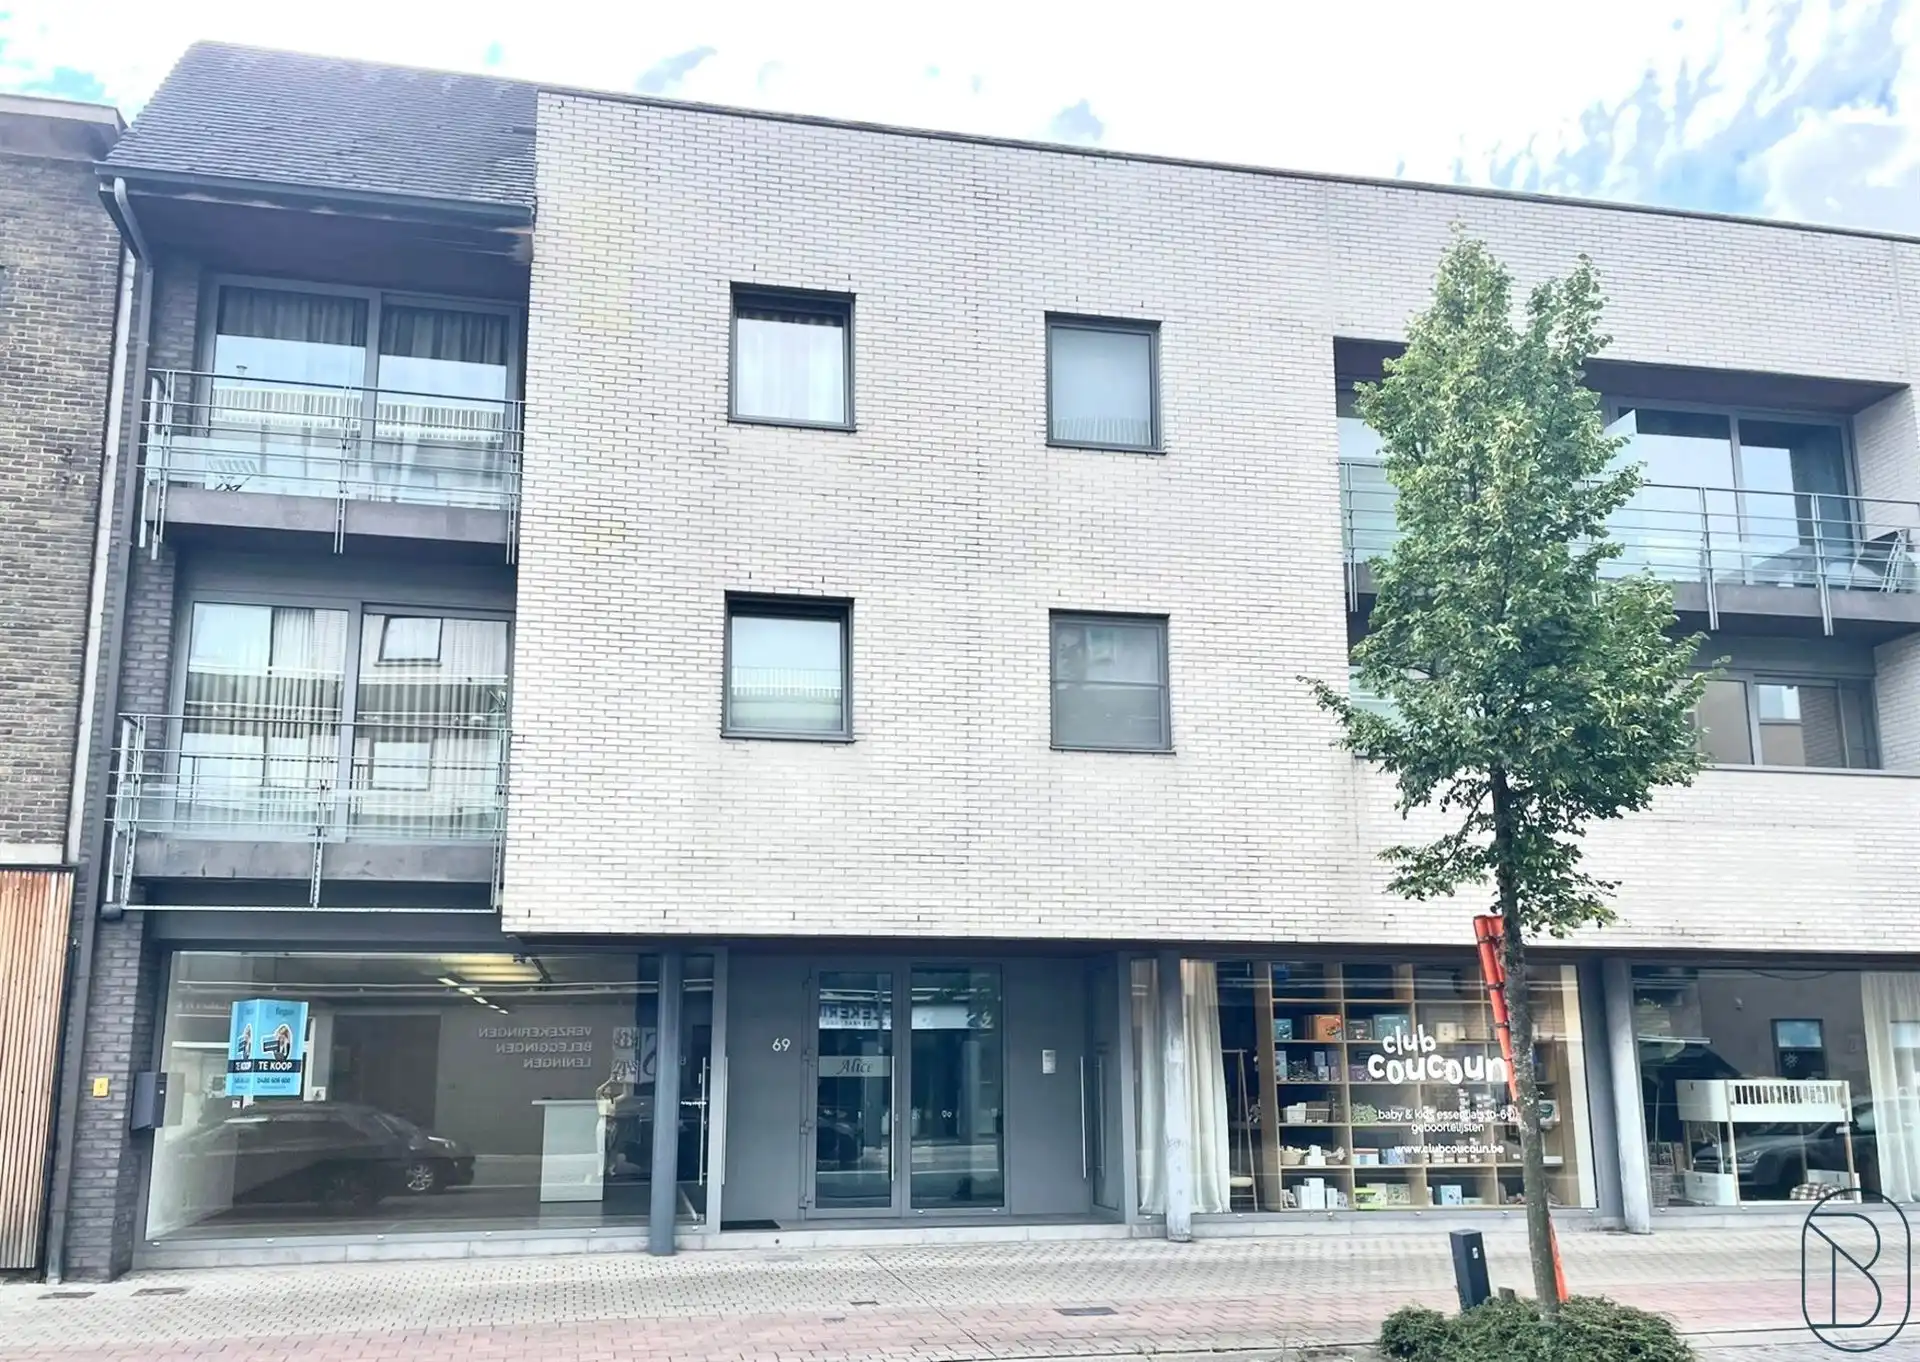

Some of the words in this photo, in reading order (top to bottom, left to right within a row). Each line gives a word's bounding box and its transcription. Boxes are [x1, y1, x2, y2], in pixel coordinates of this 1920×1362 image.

[772, 1038, 791, 1052] 69
[1382, 1024, 1436, 1055] club
[258, 1061, 268, 1070] TE
[270, 1061, 292, 1070] KOOP
[836, 1057, 874, 1075] Alice
[1367, 1054, 1508, 1085] coucoun
[1378, 1109, 1403, 1121] baby
[1405, 1109, 1414, 1120] &
[1415, 1109, 1434, 1120] kids
[1411, 1122, 1484, 1134] geboortelijsten
[1394, 1143, 1504, 1154] www.clubcoucoun.be
